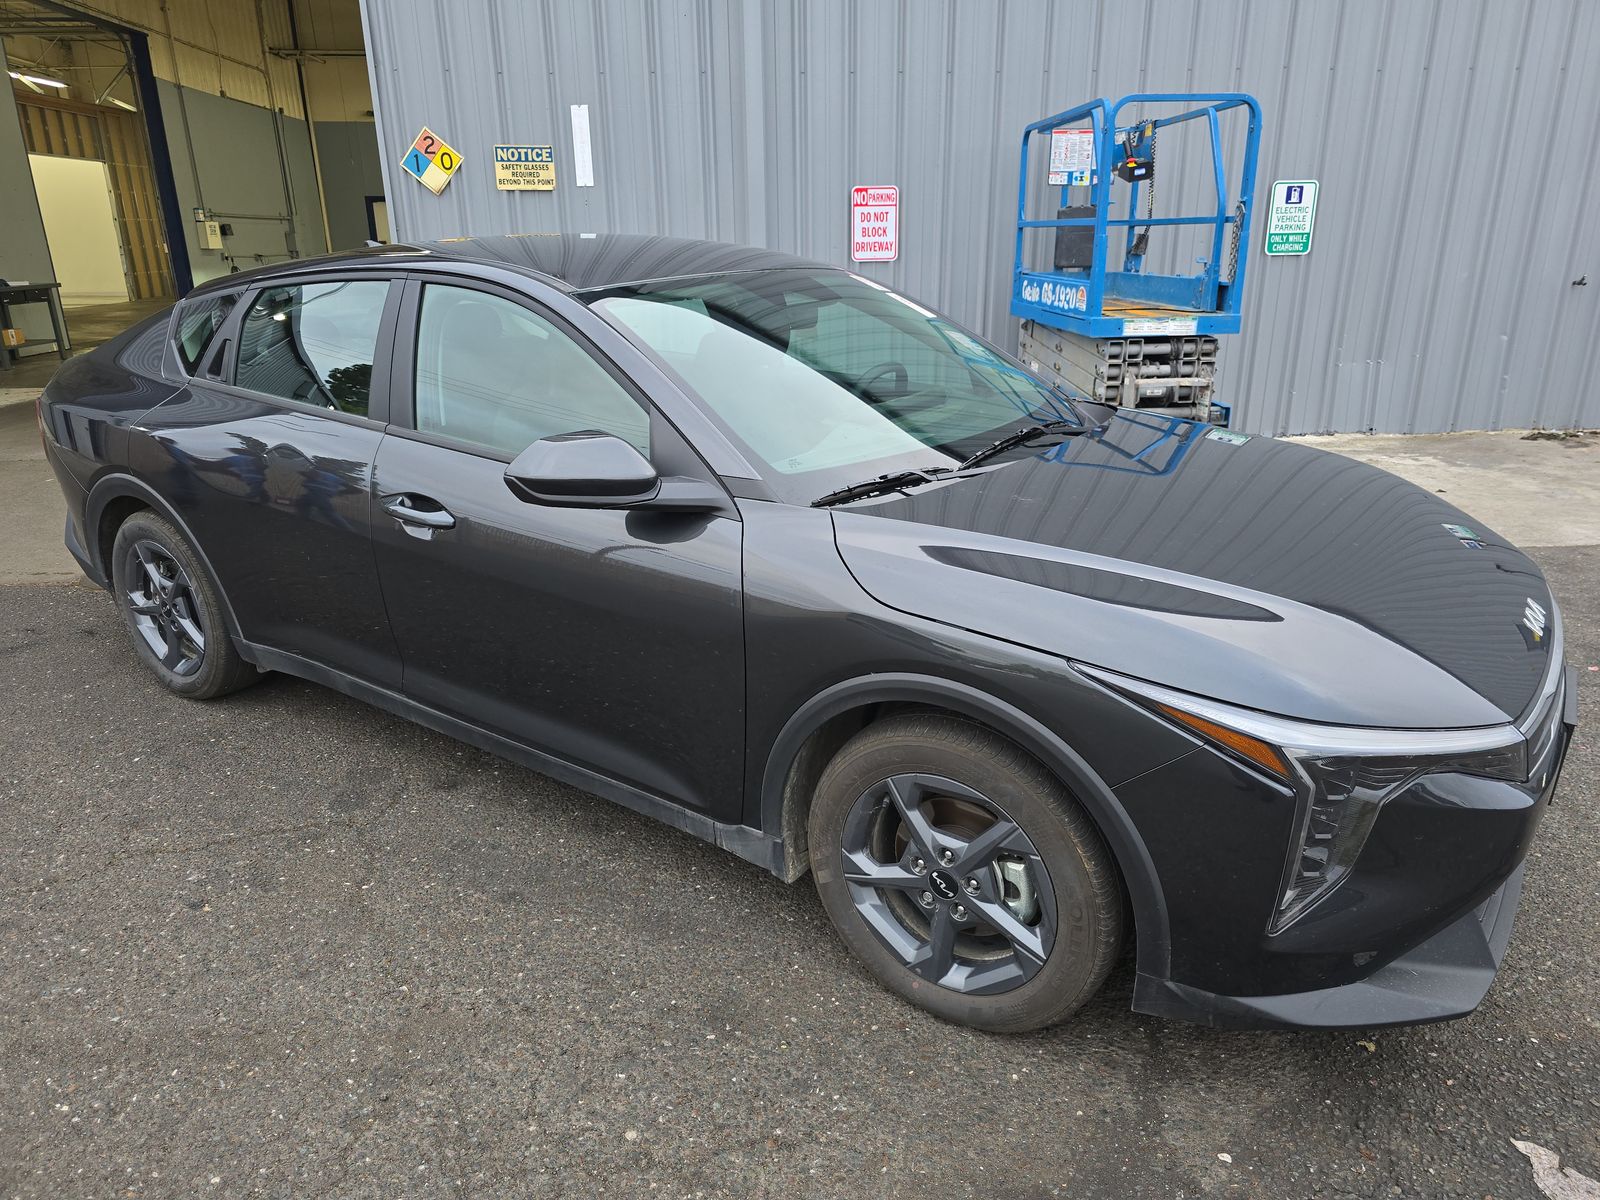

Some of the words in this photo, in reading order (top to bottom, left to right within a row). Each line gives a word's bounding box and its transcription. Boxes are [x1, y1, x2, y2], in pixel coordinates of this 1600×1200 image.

[423, 136, 435, 154] 2
[497, 148, 551, 161] NOTICE
[414, 154, 420, 172] 1
[440, 152, 453, 170] 0
[499, 178, 521, 186] BEYOND
[523, 178, 536, 186] THIS
[537, 178, 554, 186] POINT
[854, 191, 867, 205] NO
[868, 193, 895, 203] PARKING
[1275, 206, 1310, 215] ELECTRIC
[860, 212, 871, 223] DO
[874, 211, 889, 223] NOT
[1276, 215, 1307, 223] VEHICLE
[861, 226, 888, 238] BLOCK
[1274, 223, 1306, 231] PARKING
[1270, 234, 1288, 243] ONLY
[1288, 234, 1307, 243] WHILE
[855, 241, 894, 253] DRIVEWAY
[1272, 243, 1304, 252] CHARGING
